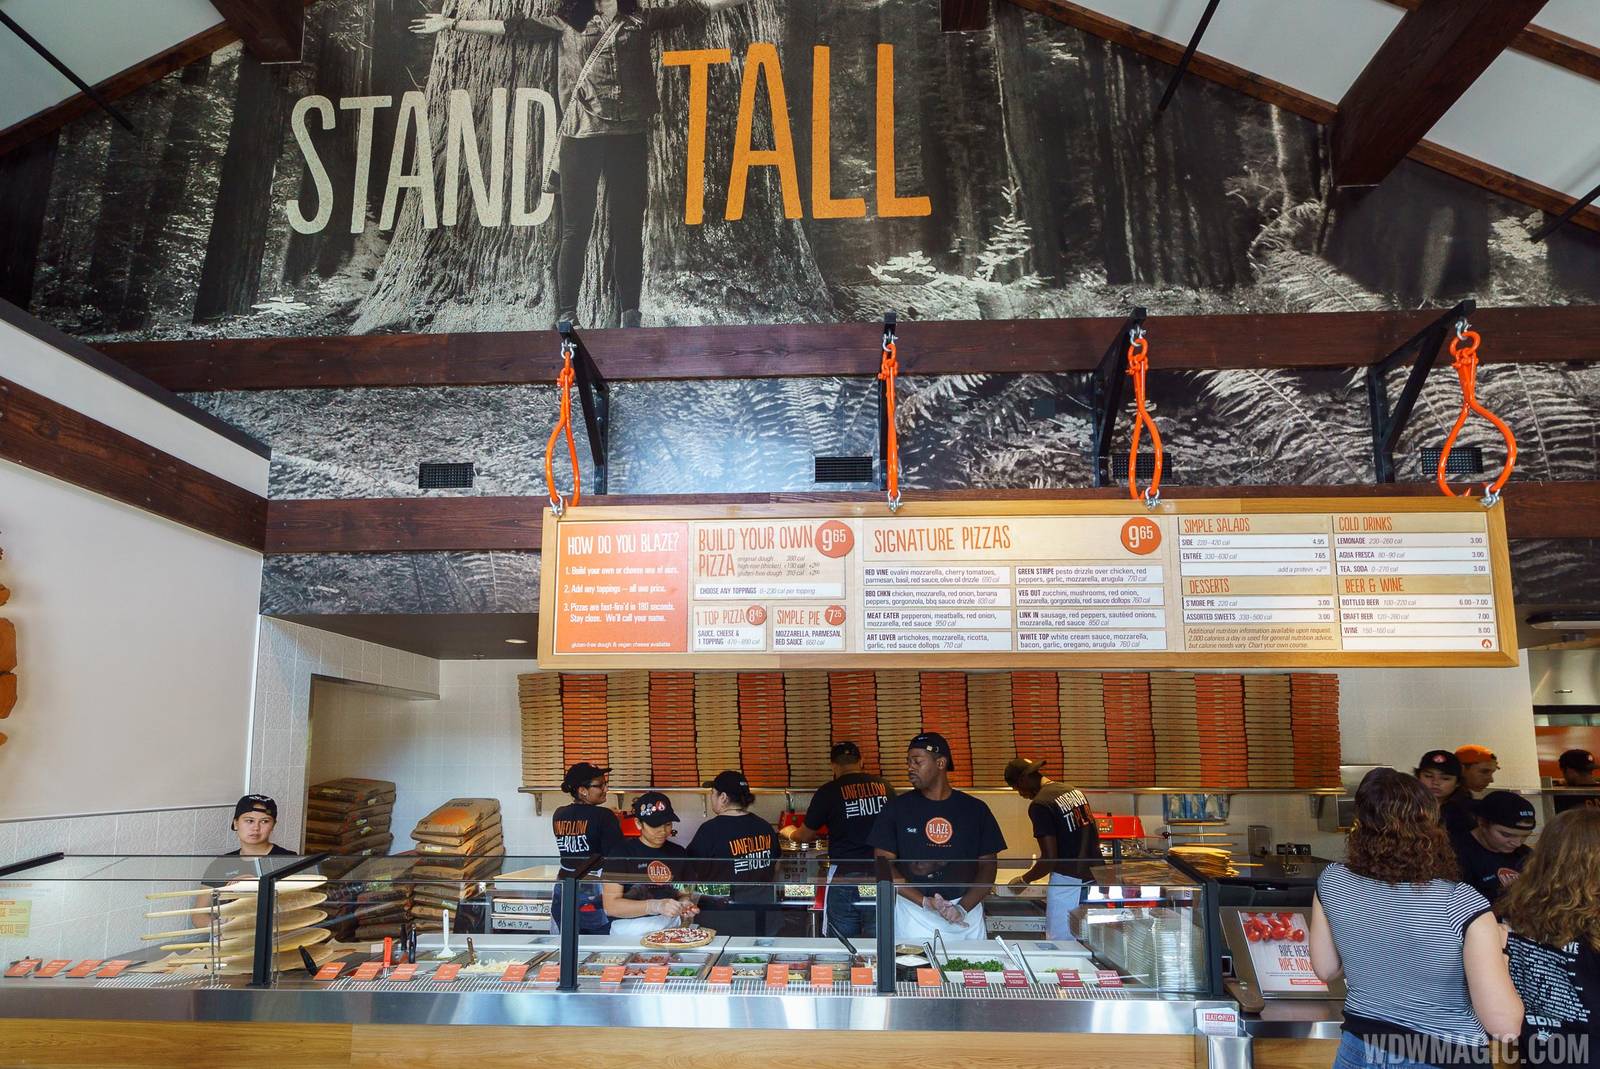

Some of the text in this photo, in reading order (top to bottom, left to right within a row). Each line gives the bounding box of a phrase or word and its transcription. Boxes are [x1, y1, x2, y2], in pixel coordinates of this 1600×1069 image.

[286, 42, 932, 235] STAND TALL
[1184, 517, 1250, 533] SIMPLE SALADS
[1339, 517, 1392, 531] COLD DRINKS
[568, 532, 680, 555] HOW DO YOU BLAZE?
[699, 525, 813, 551] BUILD YOUR OWN
[875, 525, 1011, 552] SIGNATURE PIZZAS
[699, 554, 735, 576] PIZZA
[1190, 578, 1229, 593] DESSERTS
[1346, 578, 1403, 593] BEER & WINE
[705, 611, 718, 625] TOP
[723, 610, 746, 624] PIZZA
[777, 610, 820, 625] SIMPLE PIE
[841, 782, 887, 799] UNFOLLOW
[845, 800, 860, 818] THE
[929, 824, 949, 834] BLAZE
[564, 835, 590, 852] RULES
[729, 834, 771, 856] UNFOLLOW
[748, 850, 771, 869] RULES
[650, 866, 667, 876] BLAZE
[1279, 945, 1294, 957] RIPE
[1279, 958, 1296, 970] RIPE
